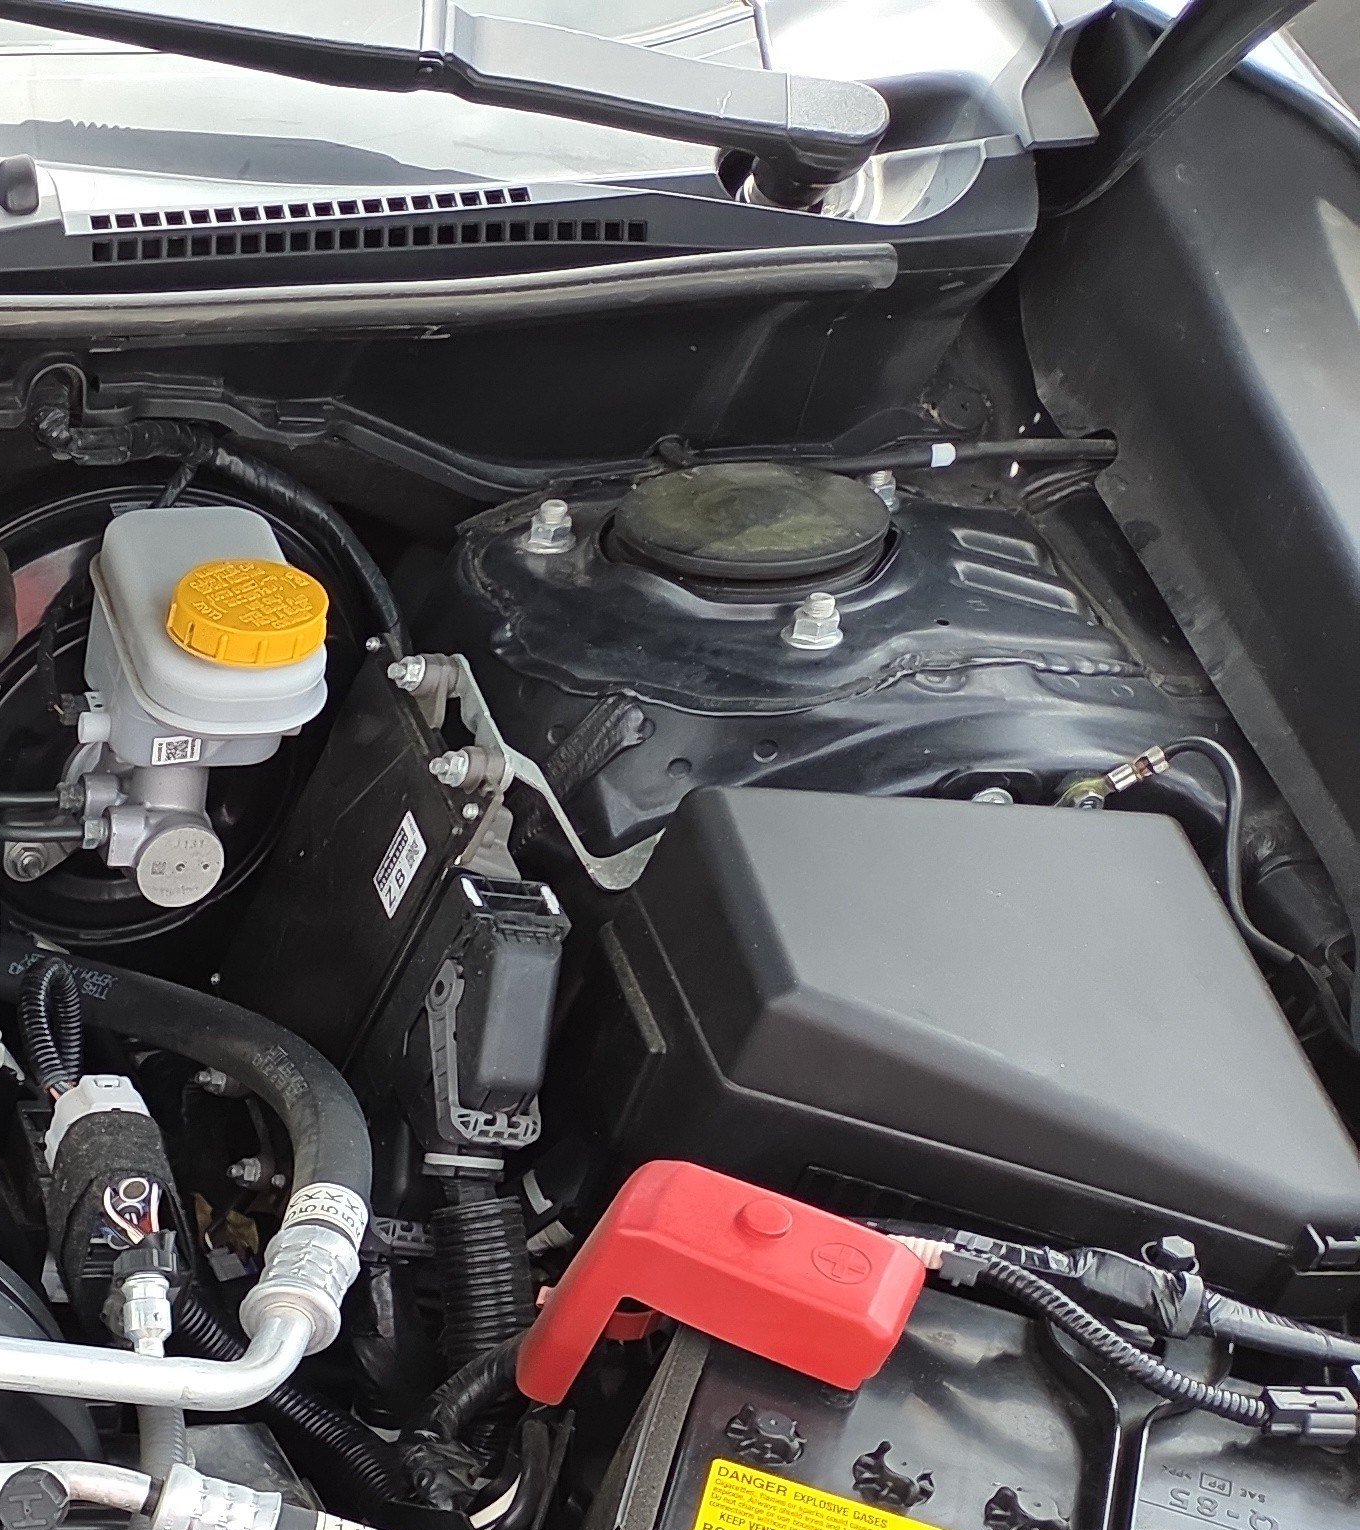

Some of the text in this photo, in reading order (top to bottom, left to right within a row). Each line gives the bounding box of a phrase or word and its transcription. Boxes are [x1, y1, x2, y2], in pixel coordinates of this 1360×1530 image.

[717, 1465, 787, 1496] DANGER
[719, 1511, 745, 1528] KEEP
[793, 1491, 888, 1529] EXPLOSIVE GASES
